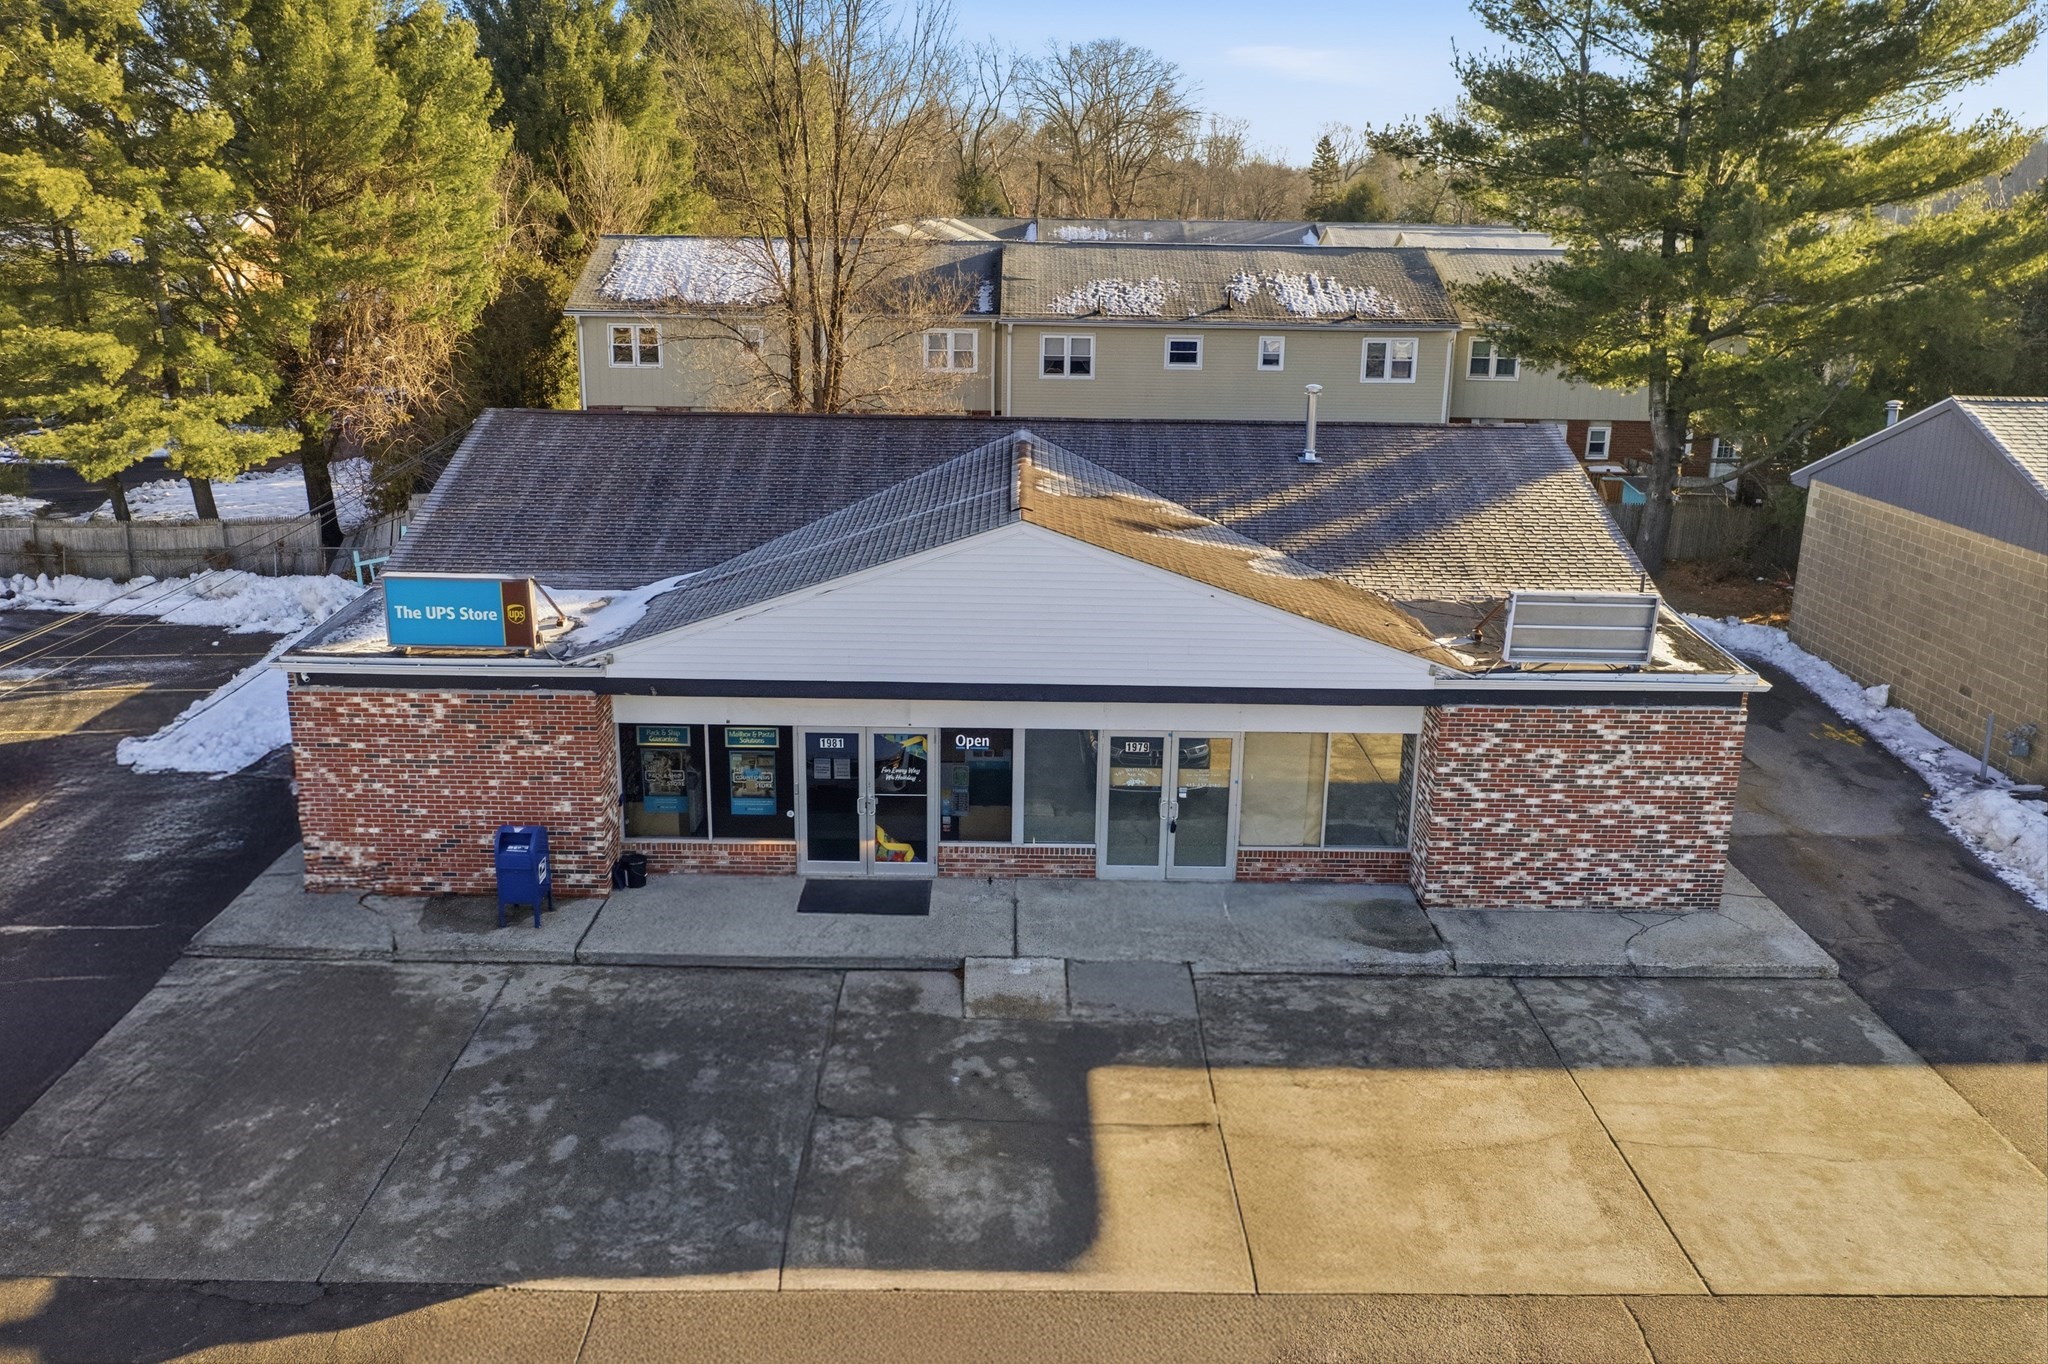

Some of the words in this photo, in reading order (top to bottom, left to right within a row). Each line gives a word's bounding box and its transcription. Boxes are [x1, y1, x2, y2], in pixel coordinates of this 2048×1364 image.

[394, 605, 422, 619] The
[425, 606, 456, 620] UPS
[459, 607, 498, 621] Store
[509, 609, 524, 621] ups
[821, 738, 843, 748] 1981
[955, 734, 990, 749] Open
[1126, 742, 1149, 752] 1979
[908, 767, 921, 775] Way
